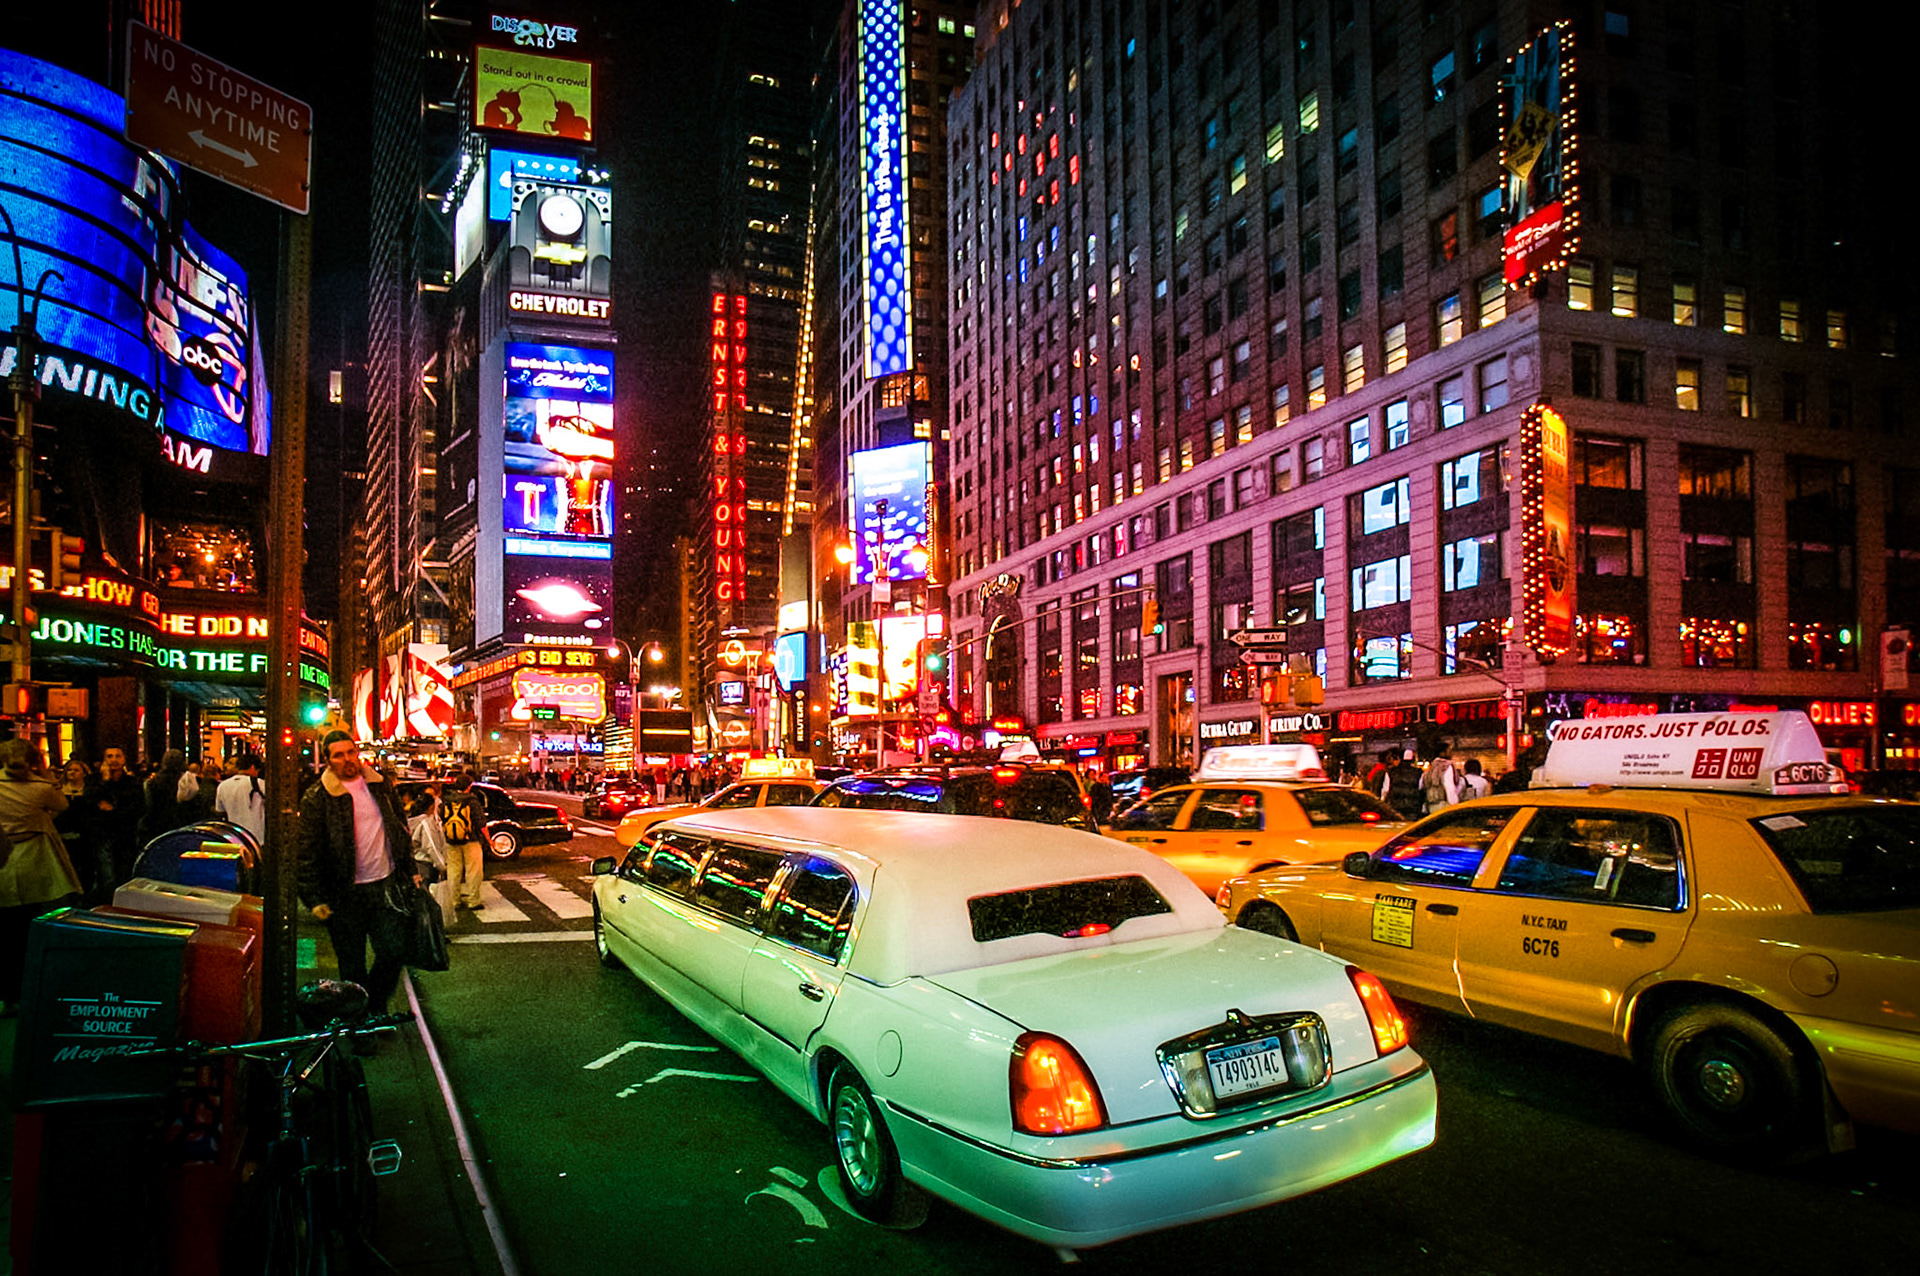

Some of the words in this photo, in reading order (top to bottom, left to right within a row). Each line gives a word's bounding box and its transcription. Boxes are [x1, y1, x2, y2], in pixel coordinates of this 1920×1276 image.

[514, 35, 555, 49] CARD
[483, 63, 512, 77] Stand
[515, 70, 531, 80] out
[534, 71, 544, 82] in
[547, 75, 554, 83] a
[144, 39, 175, 71] NO
[191, 63, 299, 130] STOPPING
[164, 86, 280, 153] ANYTIME
[876, 212, 891, 249] This
[510, 292, 610, 318] CHEVROLET
[183, 345, 222, 375] abc
[712, 295, 729, 411] ERNST
[715, 435, 729, 453] &
[714, 477, 733, 600] YOUNG
[31, 617, 124, 649] JONES
[161, 613, 196, 635] HE
[200, 616, 243, 637] DID
[524, 633, 593, 646] Panasonic
[189, 651, 244, 672] THE
[518, 680, 600, 697] YAHOO!
[1811, 701, 1876, 726] OLLIE'S
[1200, 722, 1227, 739] BUBBA
[1228, 720, 1253, 737] GUMP
[1270, 716, 1302, 733] HRIMP
[1557, 727, 1579, 741] NO
[1581, 724, 1647, 740] GATORS.
[1649, 721, 1698, 738] JUST
[1701, 719, 1770, 736] POLOS.
[1733, 752, 1757, 762] UNI
[1730, 764, 1756, 776] QLO
[1791, 765, 1825, 781] 6C76
[1546, 917, 1568, 931] TAXI
[1522, 937, 1560, 958] 6C76
[104, 992, 119, 1002] The
[70, 1005, 149, 1019] EMPLOYMENT
[83, 1020, 132, 1033] SOURCE
[1215, 1052, 1279, 1087] T490314C
